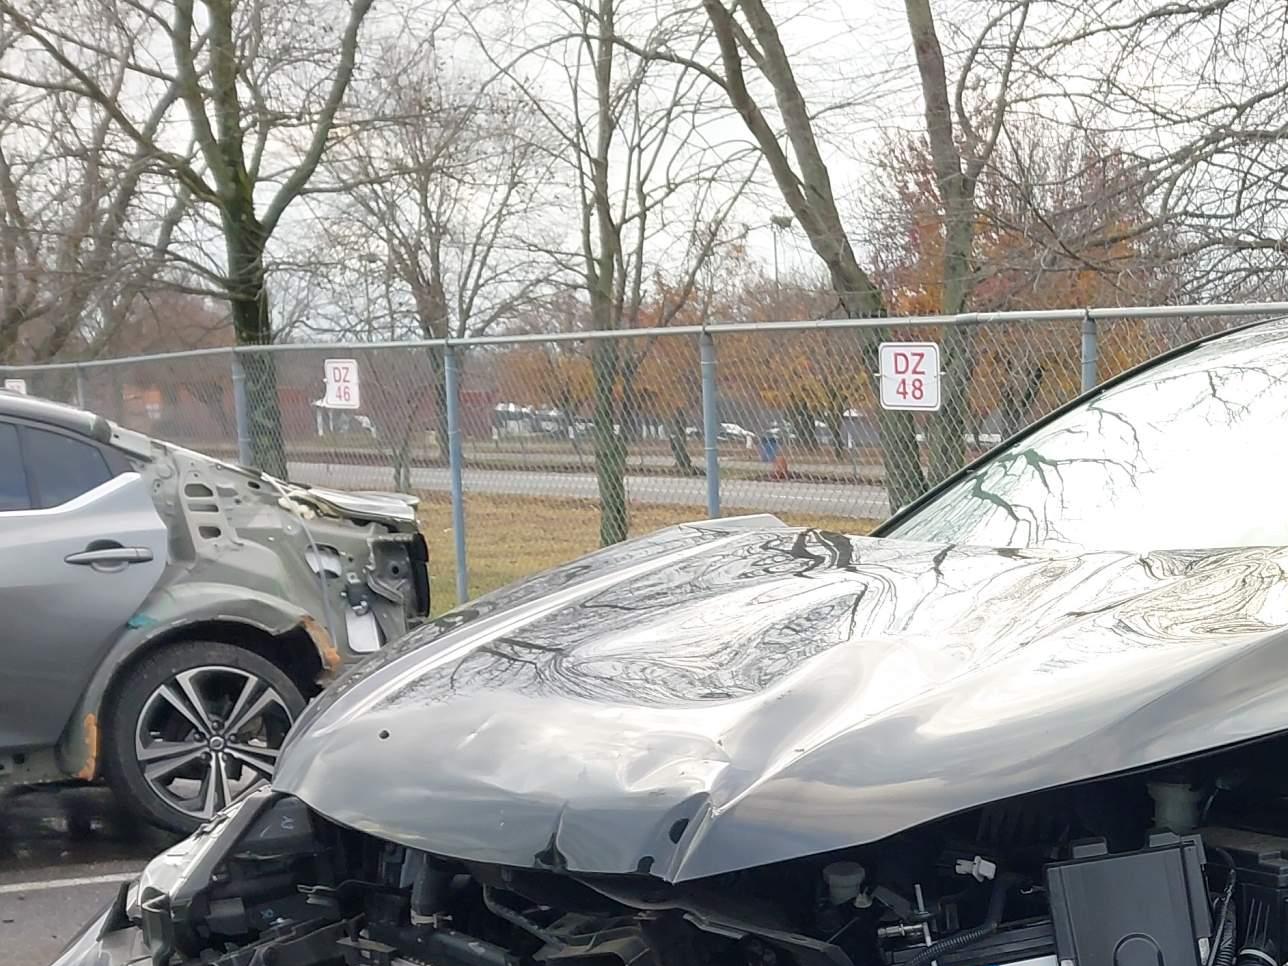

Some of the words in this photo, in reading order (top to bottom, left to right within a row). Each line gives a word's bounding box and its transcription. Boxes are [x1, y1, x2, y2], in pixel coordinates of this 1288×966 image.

[893, 352, 926, 375] DZ
[332, 366, 351, 383] DZ
[335, 385, 351, 402] 46
[895, 377, 924, 400] 48
